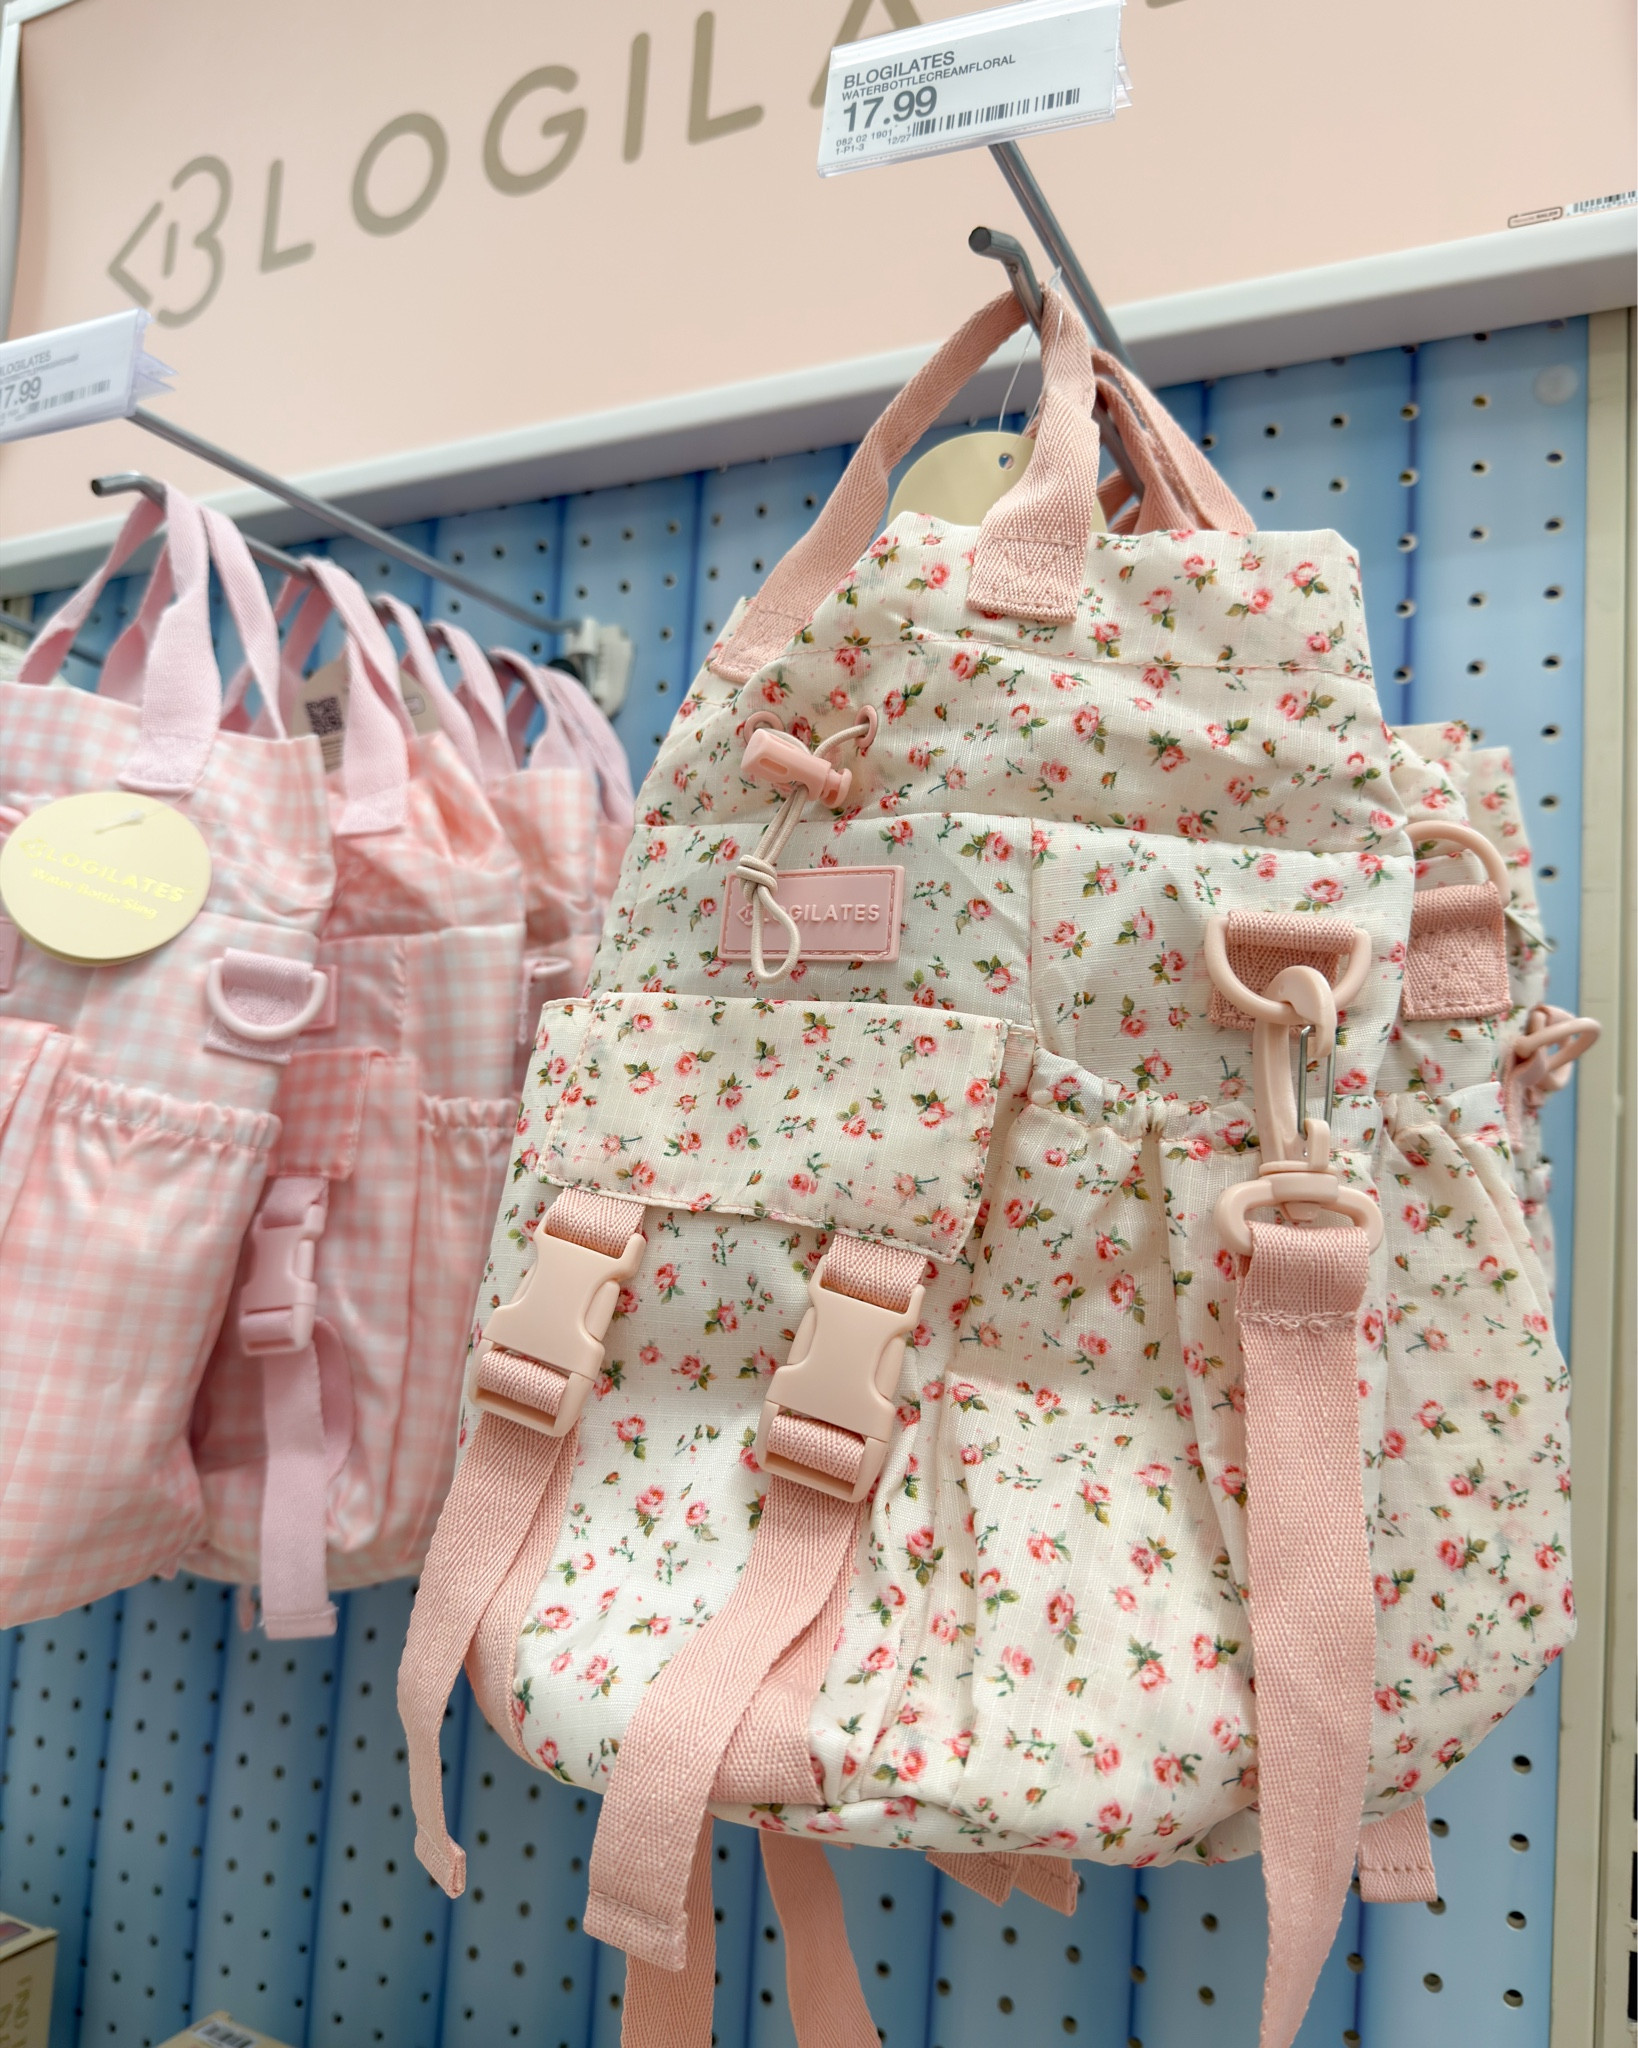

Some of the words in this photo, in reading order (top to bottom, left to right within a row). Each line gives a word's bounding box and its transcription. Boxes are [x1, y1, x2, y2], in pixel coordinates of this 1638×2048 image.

[841, 54, 1017, 101] WATERBOTTLECREAMFLORAL
[843, 51, 956, 90] BLOGILATES
[843, 85, 938, 133] 17.99
[836, 138, 854, 147] 082
[856, 134, 868, 143] 02
[871, 129, 893, 140] 1901
[888, 133, 912, 145] 12/27
